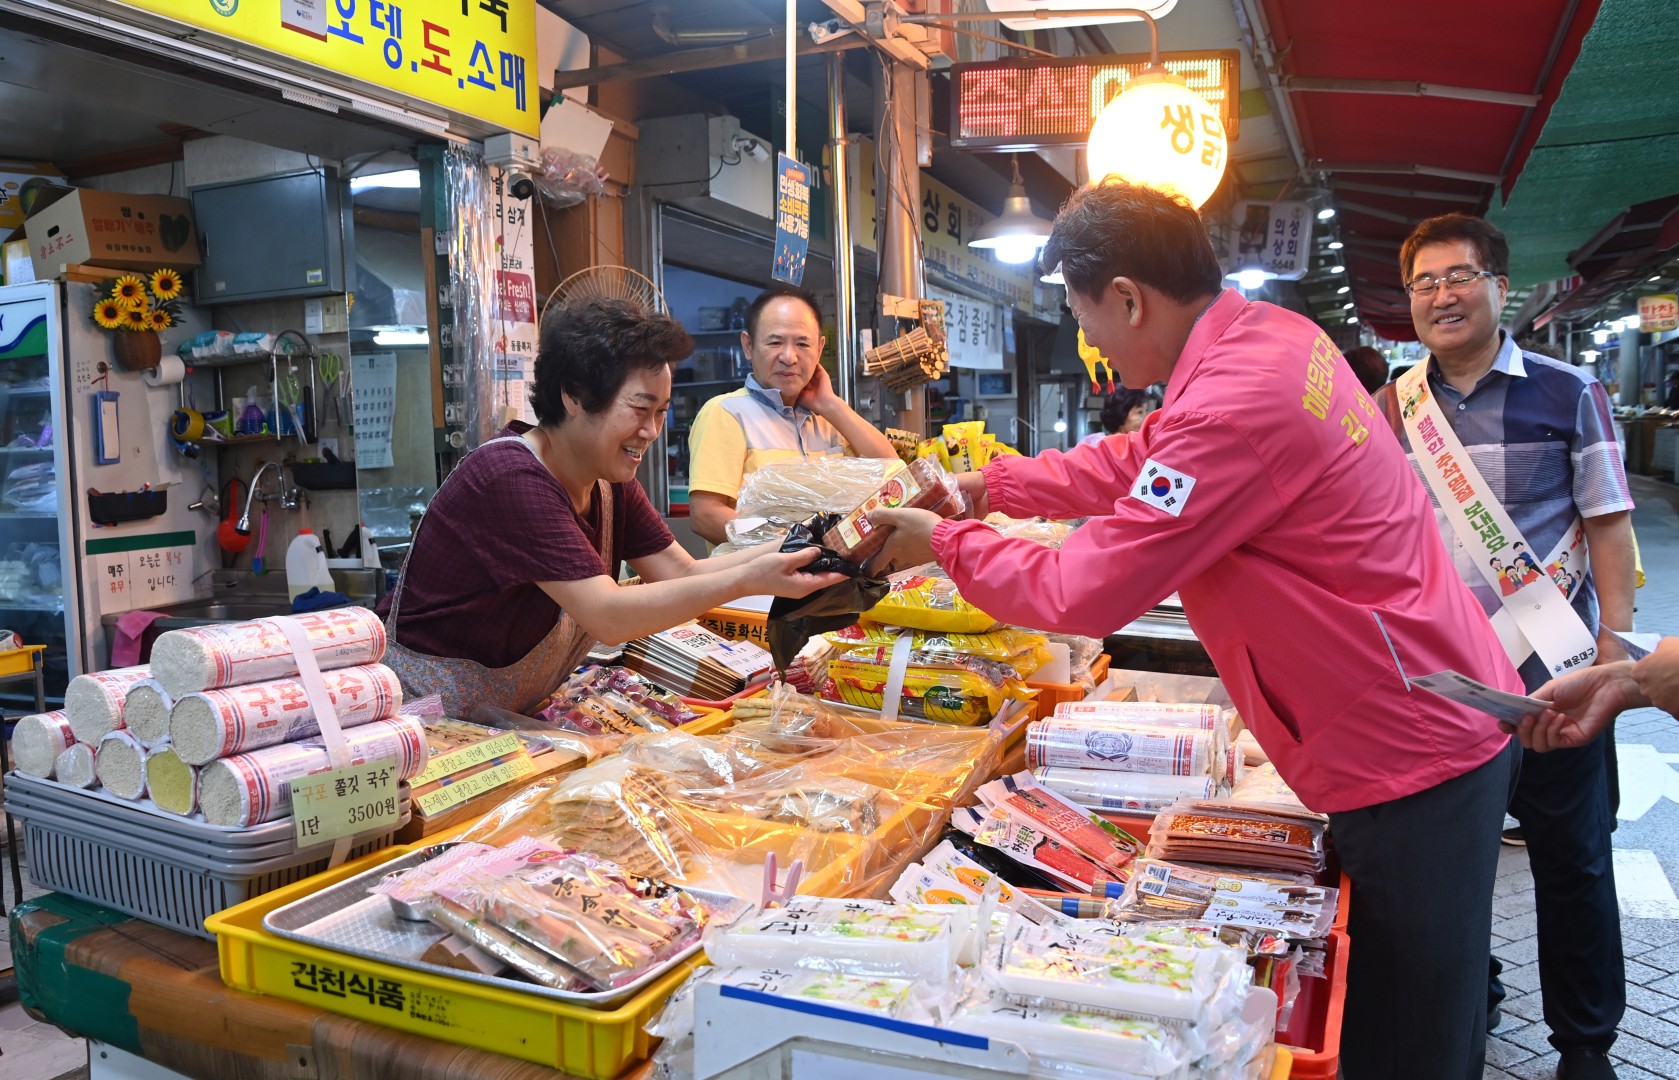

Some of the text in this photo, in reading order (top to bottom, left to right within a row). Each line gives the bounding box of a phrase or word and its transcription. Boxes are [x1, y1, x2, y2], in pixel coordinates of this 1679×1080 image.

[960, 65, 1088, 136] 즉석
[779, 174, 809, 204] 민생회복
[779, 194, 809, 220] 소비쿠폰
[923, 190, 961, 245] 상회
[779, 216, 809, 239] 사용가능
[1274, 219, 1299, 237] 의성
[1273, 239, 1298, 257] 상회
[507, 280, 531, 299] Fresh!
[511, 341, 532, 352] 동물복지
[1416, 413, 1509, 555] 행복한 추석명절 보내세요
[107, 565, 124, 577] 매주
[139, 553, 161, 568] 오늘은
[110, 580, 124, 593] 휴무
[1562, 647, 1596, 670] 해운대구
[437, 755, 467, 773] 냉장고
[466, 748, 486, 763] 안에
[485, 735, 516, 756] 있습니다
[334, 774, 360, 797] 쫄깃
[422, 760, 532, 812] 수제비 냉장고 안에 있습니다
[300, 796, 396, 837] 1단 3500원
[290, 961, 406, 1012] 건천식품
